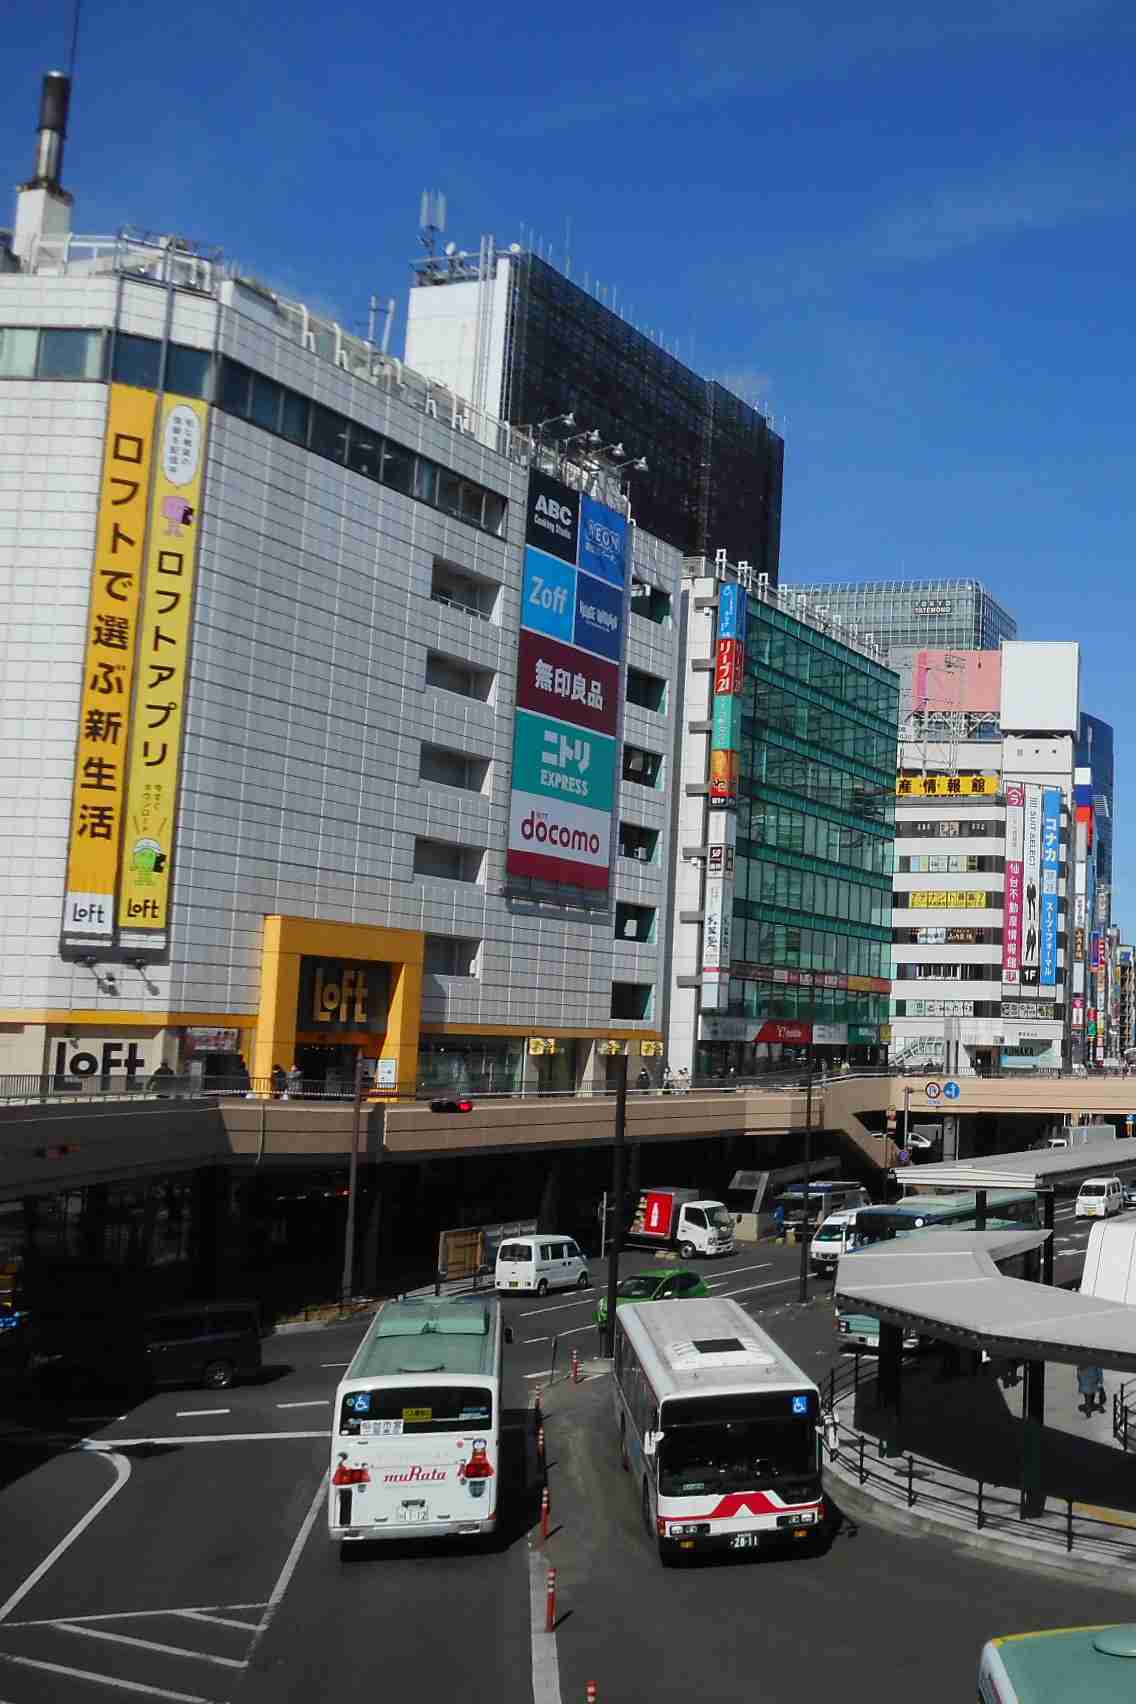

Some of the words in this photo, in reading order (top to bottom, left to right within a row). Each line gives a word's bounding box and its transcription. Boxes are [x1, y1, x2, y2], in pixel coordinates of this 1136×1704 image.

[535, 494, 572, 526] ABC
[529, 576, 568, 614] Zoff
[77, 432, 144, 841] ロフトで選ぶ新生活
[143, 550, 184, 767] ロフトアプリ
[535, 658, 604, 712] 無印良品
[542, 730, 591, 774] ニトリ
[540, 769, 588, 797] EXPRESS
[521, 810, 600, 854] docomo
[1046, 818, 1057, 862] コナカ
[1025, 970, 1036, 981] 1F
